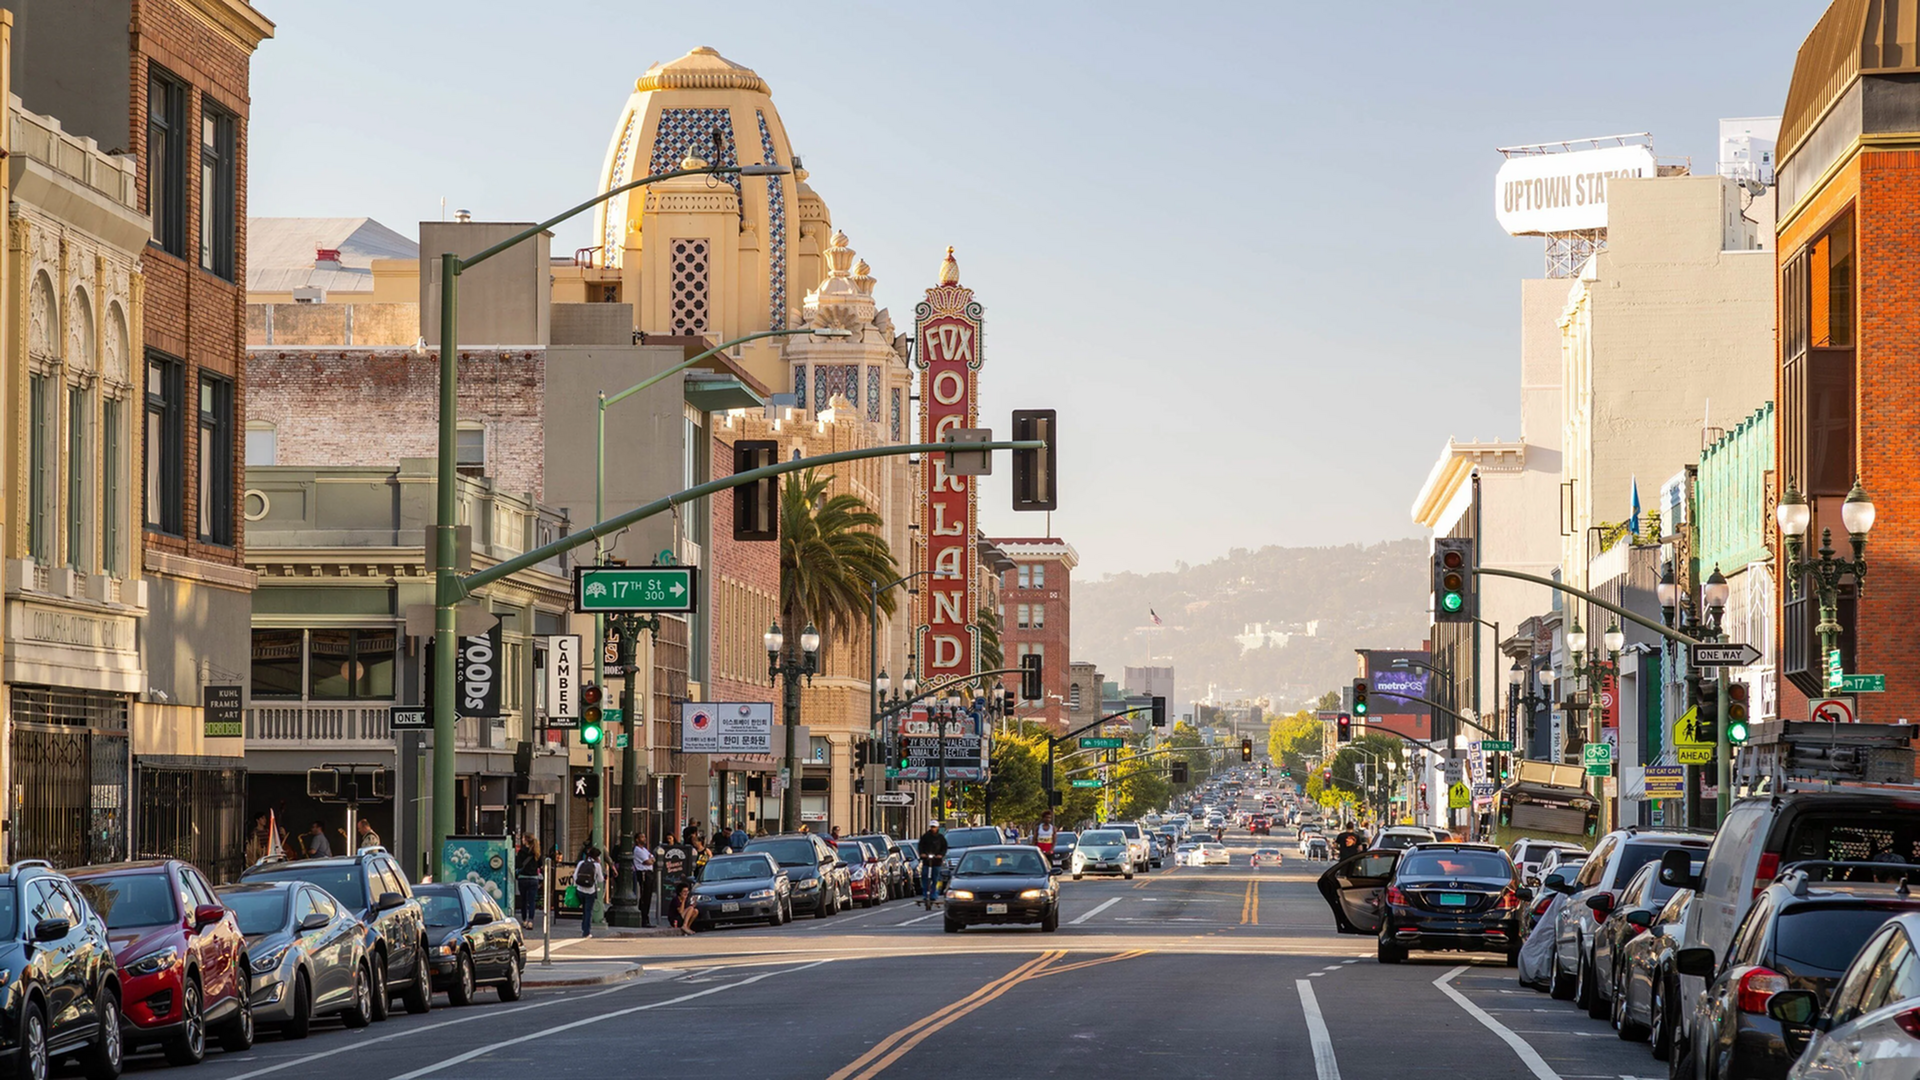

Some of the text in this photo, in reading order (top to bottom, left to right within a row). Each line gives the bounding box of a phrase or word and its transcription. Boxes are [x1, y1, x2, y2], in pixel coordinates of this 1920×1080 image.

[1504, 175, 1571, 213] UPTOWN
[925, 323, 972, 361] FOX
[612, 579, 661, 599] 17TH St
[644, 590, 665, 601] 300
[457, 648, 465, 668] BEER
[1700, 650, 1742, 660] ONE WAY
[557, 639, 570, 715] CAMBER
[1377, 682, 1423, 691] metroPCS
[210, 700, 239, 708] FRAMES
[397, 714, 417, 723] ONE
[724, 736, 739, 745] 한미
[742, 736, 766, 745] 문화원
[946, 738, 979, 748] VALENTINE
[1680, 751, 1710, 760] AHEAD
